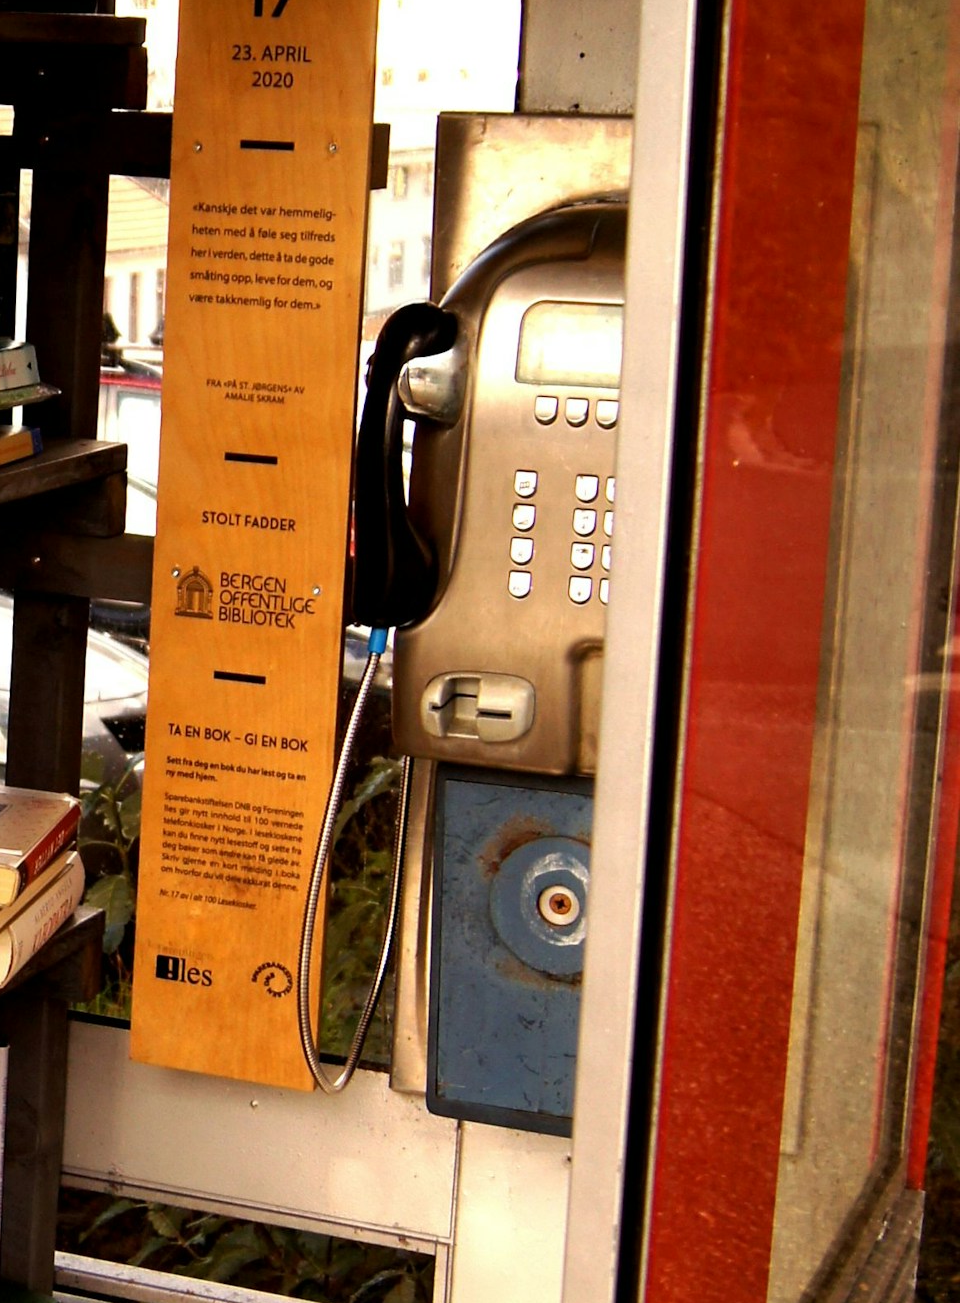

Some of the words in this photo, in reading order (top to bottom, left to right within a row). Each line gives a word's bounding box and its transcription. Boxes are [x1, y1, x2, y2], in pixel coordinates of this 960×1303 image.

[231, 44, 257, 62] 23.
[261, 45, 312, 65] APRIL
[251, 71, 295, 89] 2020
[239, 203, 257, 215] det
[260, 207, 276, 215] var
[279, 206, 335, 221] hemmelig-
[191, 223, 220, 235] heten
[223, 226, 246, 237] med
[248, 226, 255, 238] å
[257, 227, 276, 239] føle
[279, 231, 297, 242] seg
[300, 230, 335, 242] tilfreds
[191, 246, 206, 257] her
[249, 250, 275, 262] dette
[276, 251, 281, 262] å
[283, 253, 293, 262] ta
[294, 253, 307, 263] de
[308, 255, 333, 266] gode
[189, 269, 229, 284] småting
[255, 273, 275, 284] leve
[276, 274, 290, 285] for
[318, 279, 332, 290] og
[188, 294, 213, 303] være
[215, 293, 271, 309] takknemlig
[273, 296, 288, 307] for
[206, 378, 221, 387] FRA
[293, 385, 304, 394] AV
[224, 392, 253, 402] AMALIE
[256, 394, 284, 404] SKRAM
[201, 510, 241, 527] STOLT
[244, 515, 296, 531] FADDER
[220, 571, 287, 594] BERGEN
[219, 589, 316, 615] OFFENTLIGE
[218, 605, 296, 629] BIBLIOTEK
[168, 722, 182, 737] TA
[185, 725, 201, 738] EN
[204, 727, 231, 742] BOK
[244, 732, 258, 746] GI
[261, 734, 277, 748] EN
[281, 738, 309, 752] BOK
[165, 769, 175, 777] ny
[176, 770, 194, 778] med
[166, 755, 181, 765] Sett
[182, 757, 192, 766] fra
[193, 759, 208, 770] deg
[220, 762, 234, 771] bok
[236, 765, 246, 773] du
[247, 766, 260, 774] har
[261, 767, 275, 776] lest
[276, 771, 286, 780] og
